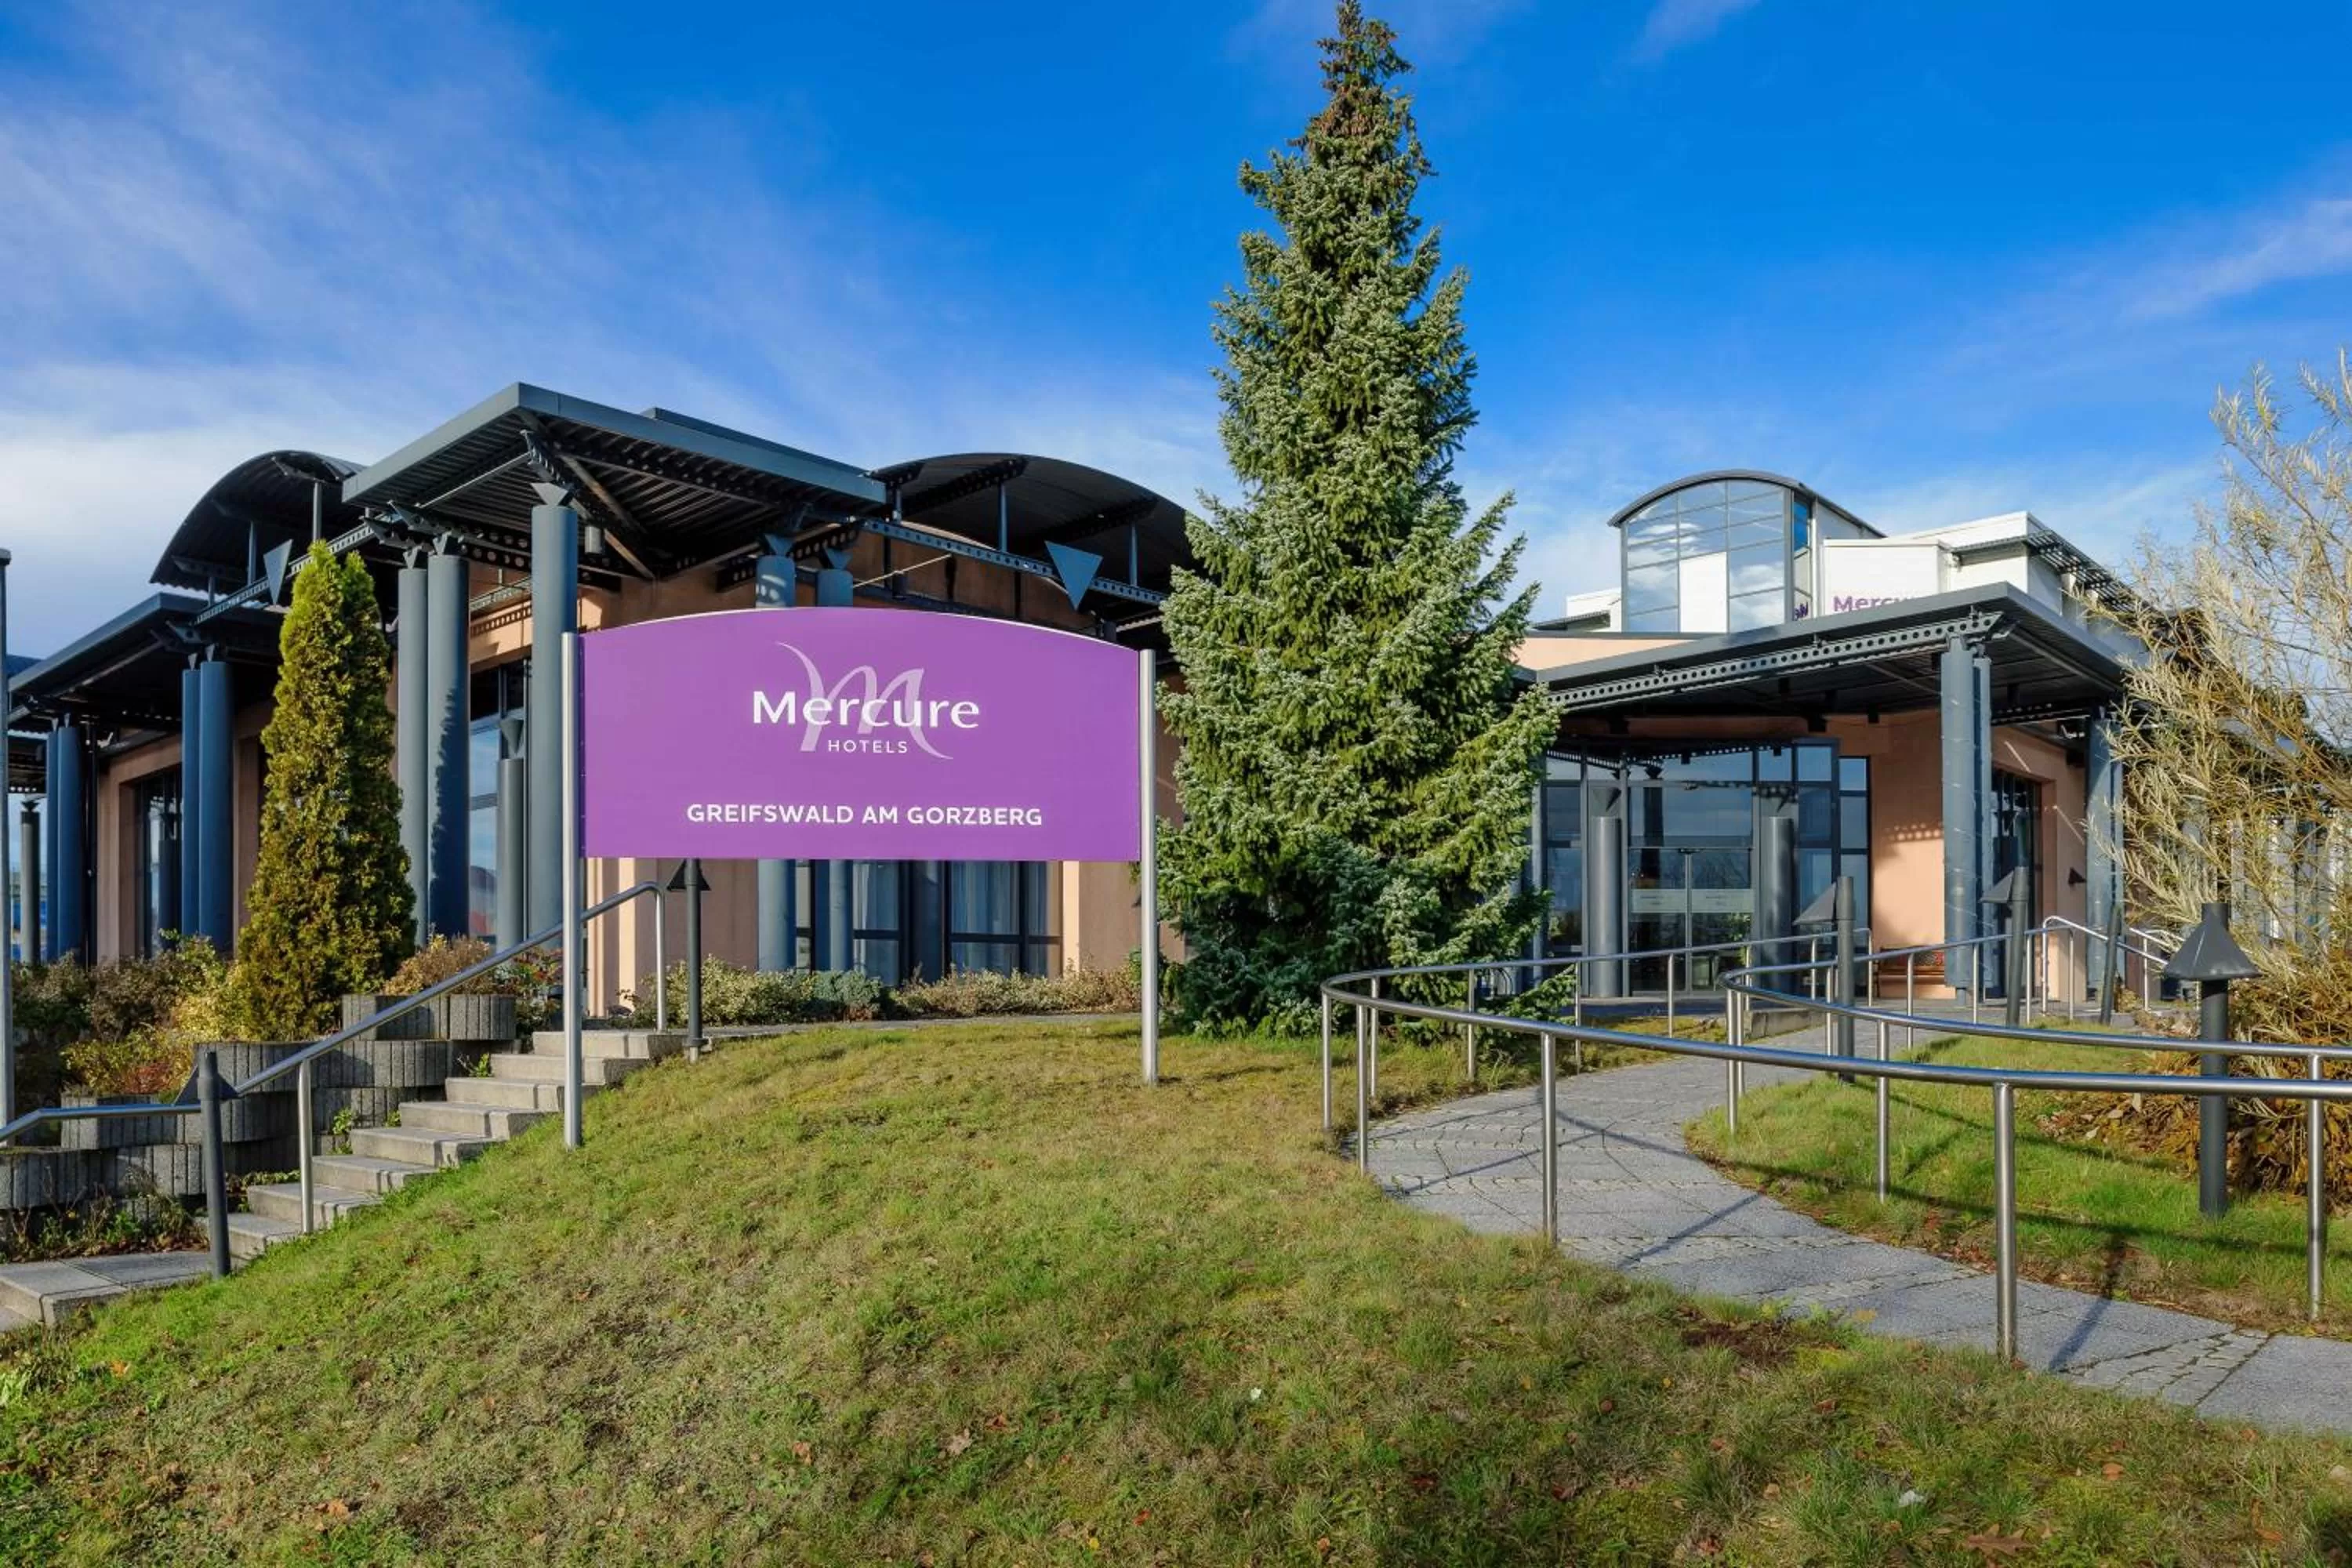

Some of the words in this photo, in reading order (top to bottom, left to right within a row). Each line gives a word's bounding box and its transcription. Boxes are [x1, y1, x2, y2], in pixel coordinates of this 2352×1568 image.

[753, 690, 980, 728] Mercure
[828, 739, 908, 753] HOTELS
[687, 804, 854, 824] GREIFSWALD
[862, 806, 898, 824] AM
[907, 807, 1043, 826] GORZBERG
